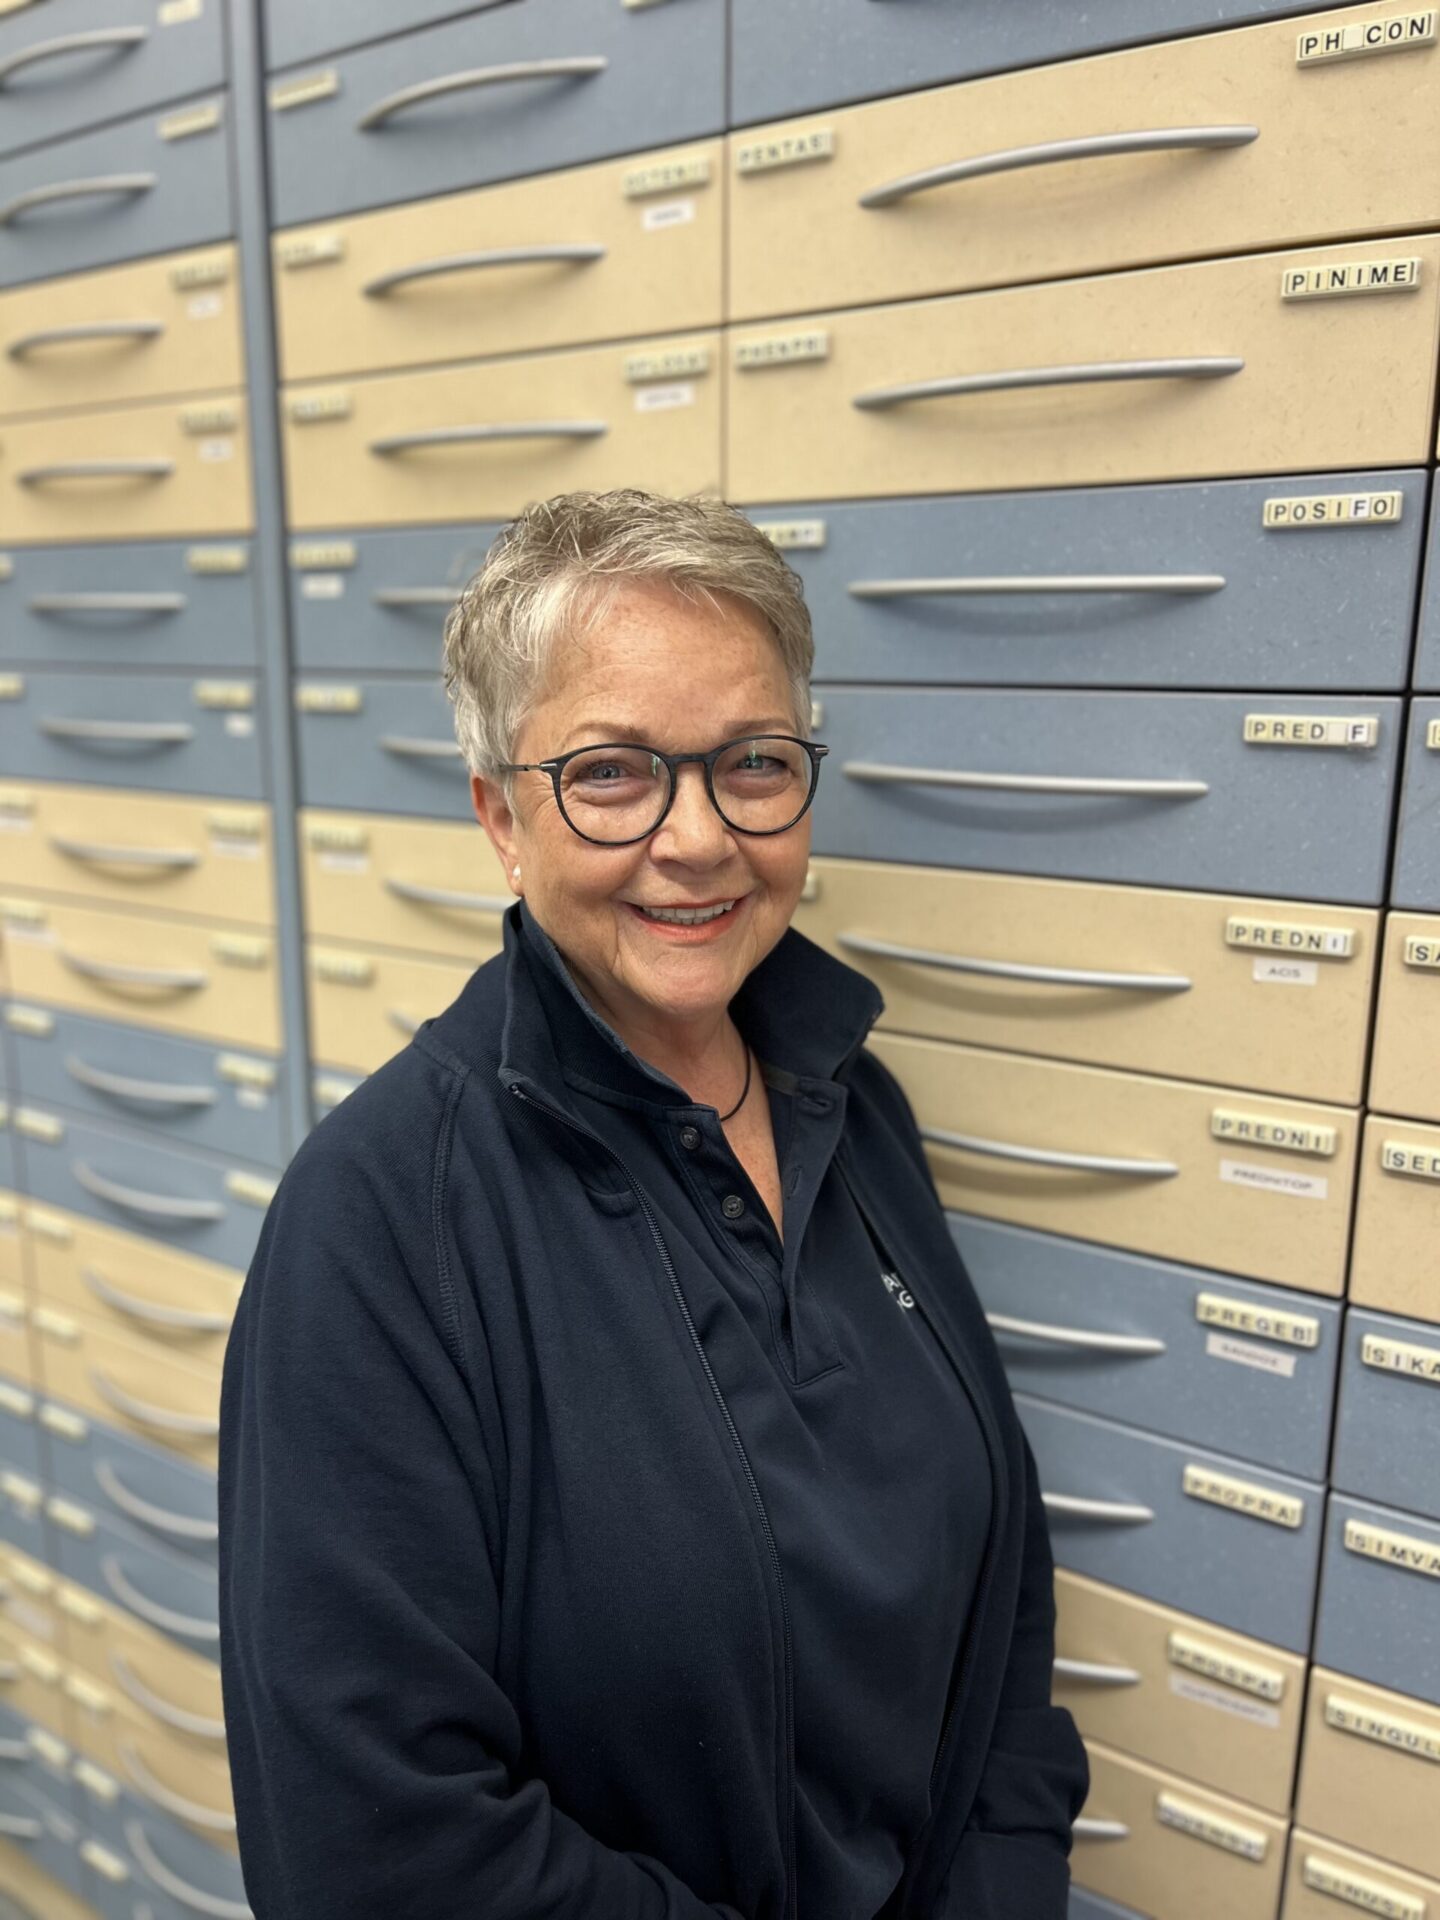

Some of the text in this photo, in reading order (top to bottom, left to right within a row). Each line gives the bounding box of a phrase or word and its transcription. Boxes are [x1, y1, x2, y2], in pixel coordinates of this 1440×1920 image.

[1304, 16, 1426, 55] PH CON
[1291, 264, 1408, 292] PINIME
[1273, 499, 1389, 521] POSIFO
[1253, 722, 1365, 740] PRED F
[1234, 925, 1338, 949] PREDNI
[1220, 1118, 1321, 1149] PREDNI
[1372, 1348, 1440, 1376] SIKA
